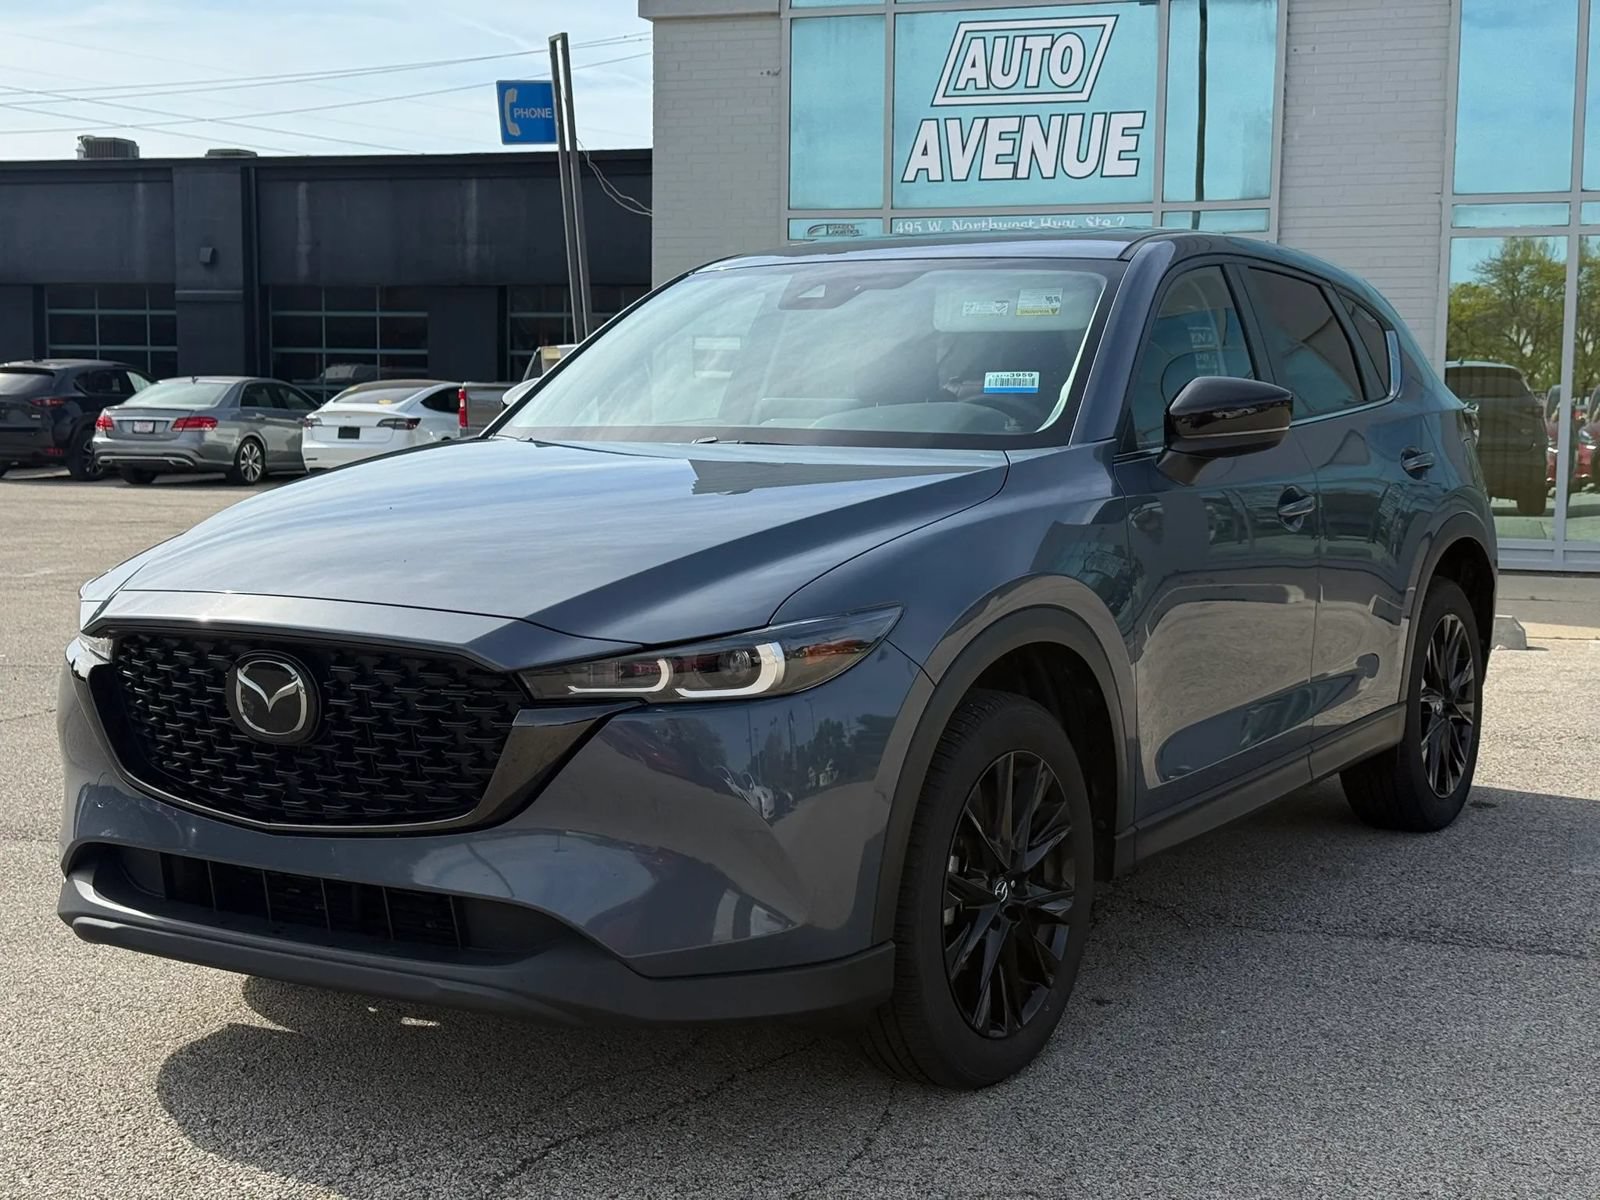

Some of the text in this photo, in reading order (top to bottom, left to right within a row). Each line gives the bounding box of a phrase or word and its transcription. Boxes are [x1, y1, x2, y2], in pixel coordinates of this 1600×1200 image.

[954, 32, 1085, 90] AUTO
[513, 107, 553, 119] PHONE
[901, 110, 1146, 183] AVENUE
[895, 219, 922, 234] 495
